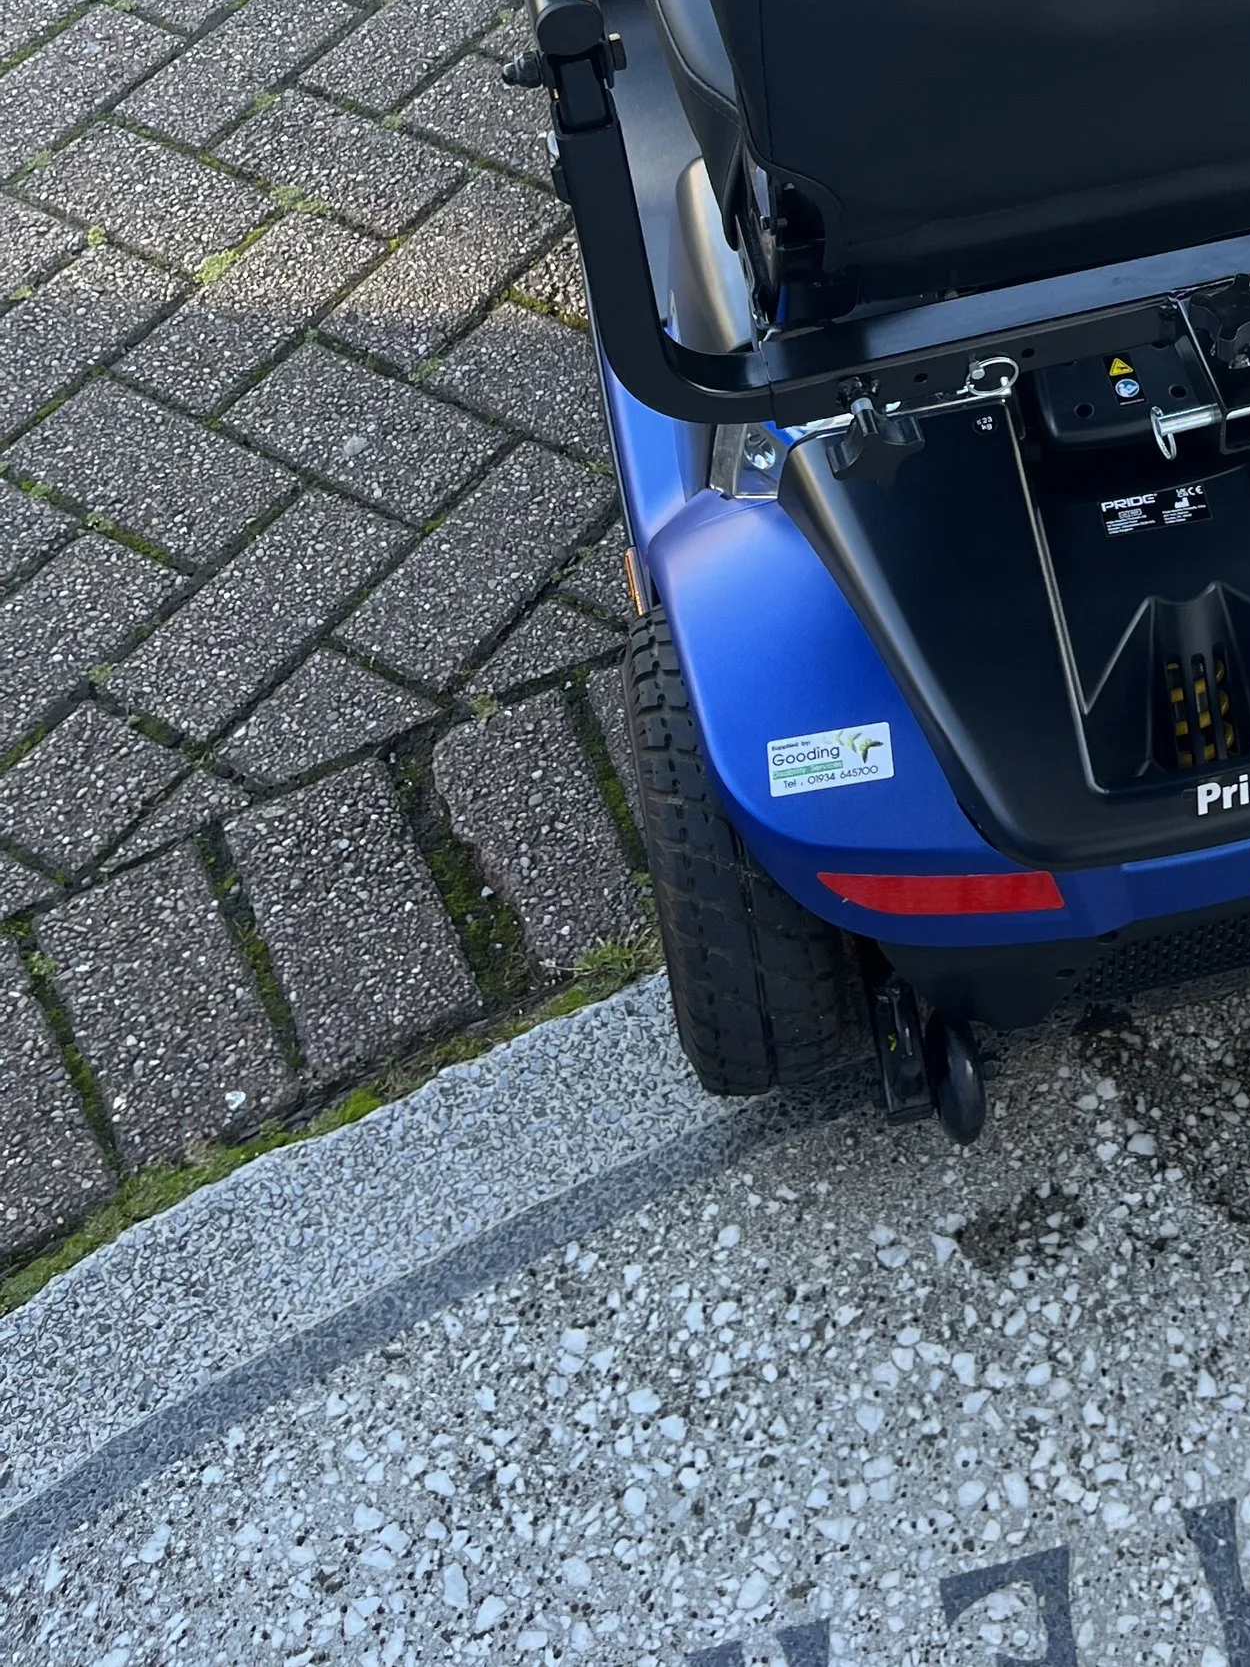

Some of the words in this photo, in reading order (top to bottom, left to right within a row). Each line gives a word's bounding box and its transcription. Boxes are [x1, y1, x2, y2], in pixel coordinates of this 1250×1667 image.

[1100, 494, 1157, 512] PRIDE
[772, 746, 840, 766] Gooding
[807, 772, 836, 785] 01934
[839, 765, 879, 780] 645700
